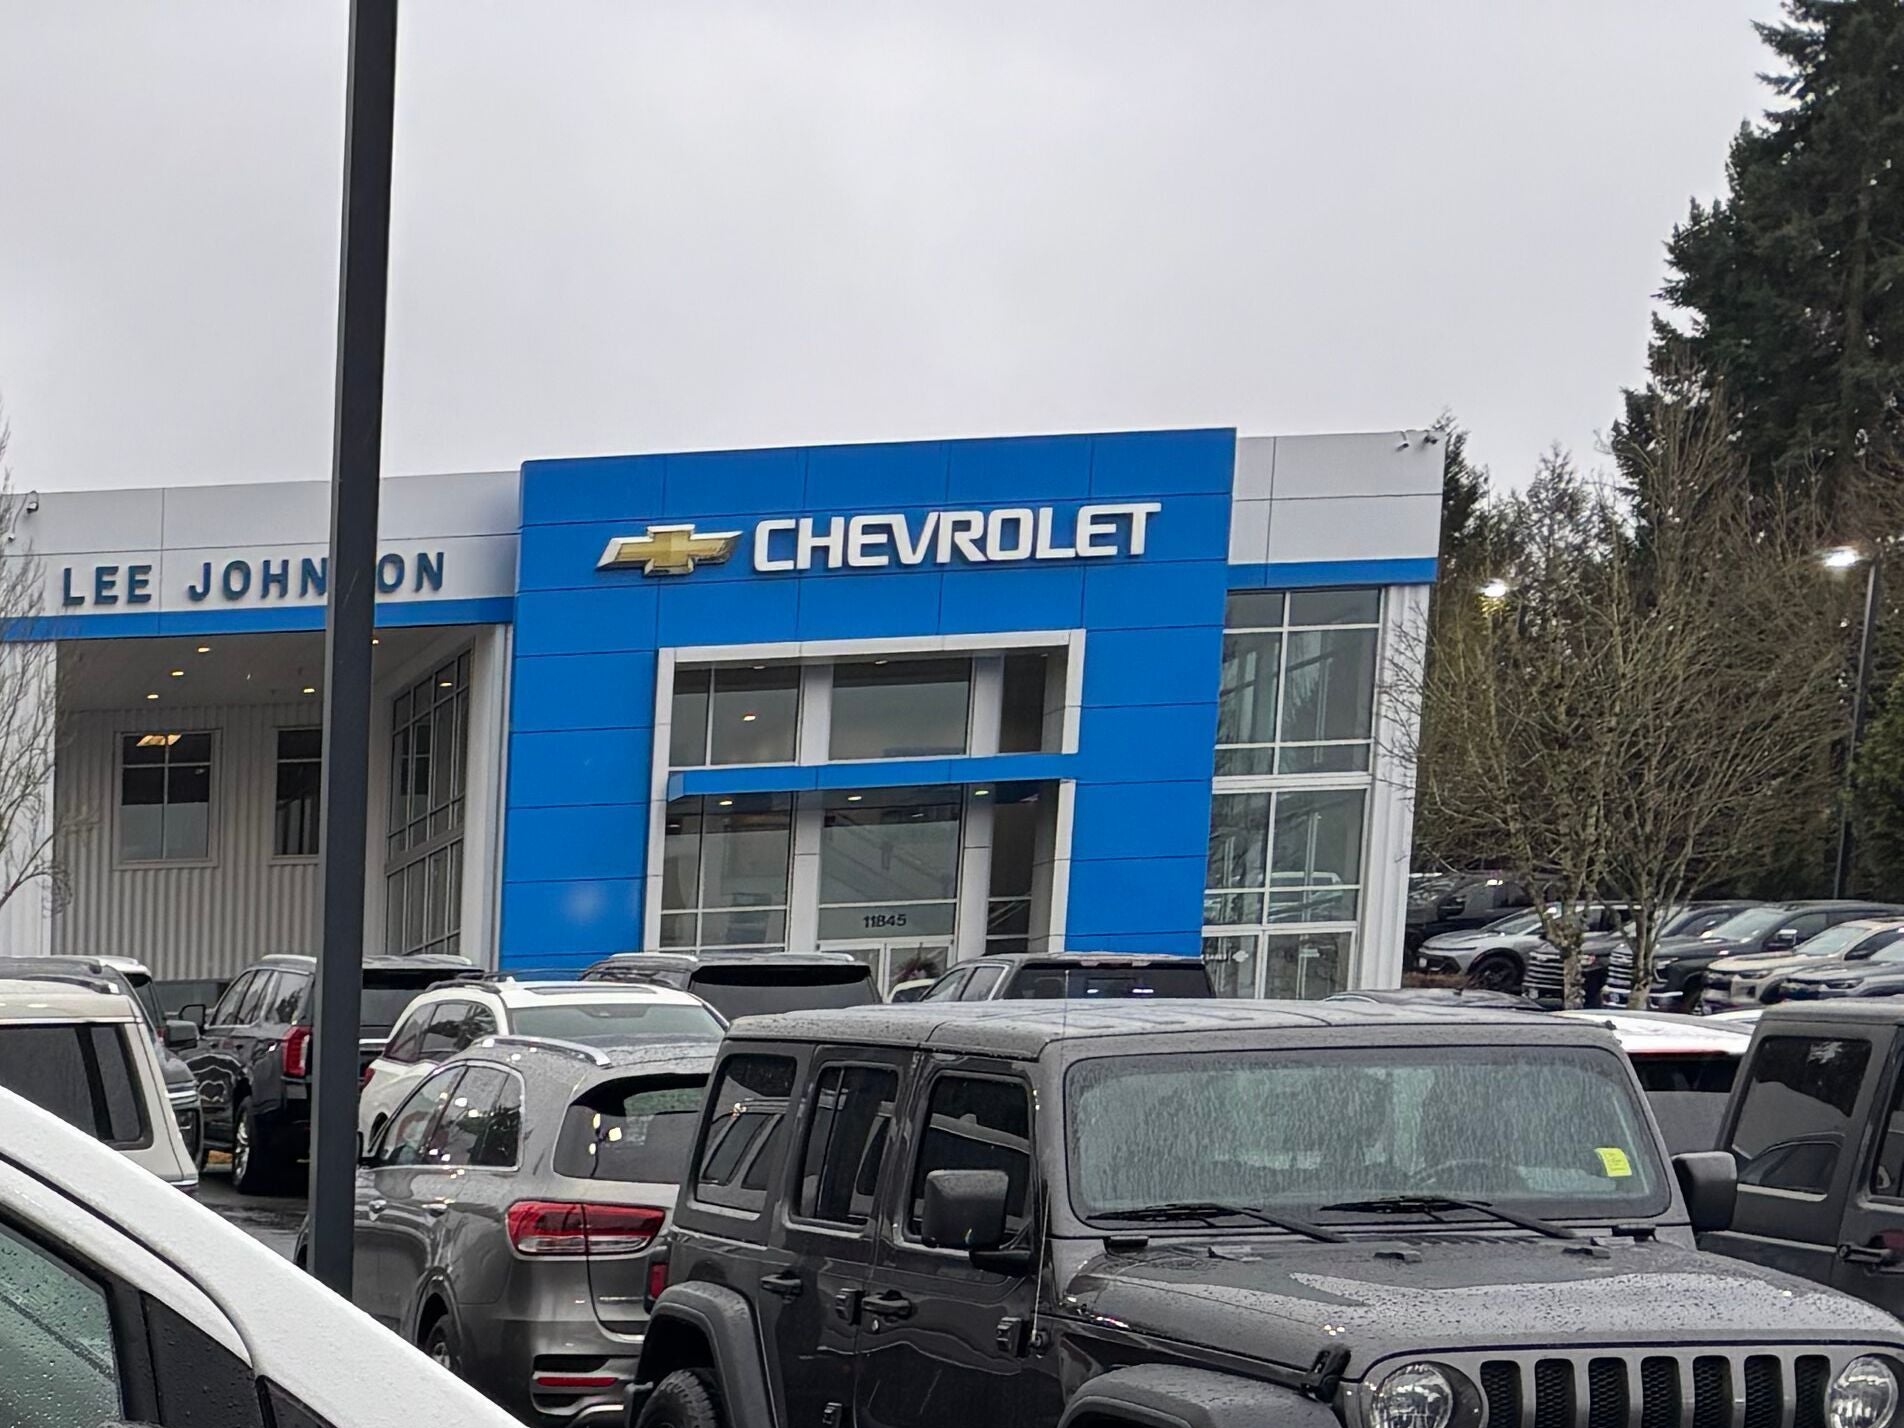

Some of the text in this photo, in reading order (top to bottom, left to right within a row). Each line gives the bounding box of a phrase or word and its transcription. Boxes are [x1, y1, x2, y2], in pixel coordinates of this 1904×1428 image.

[754, 502, 1162, 572] CHEVROLET
[62, 552, 445, 606] LEE JOHNON
[864, 914, 907, 928] 11845
